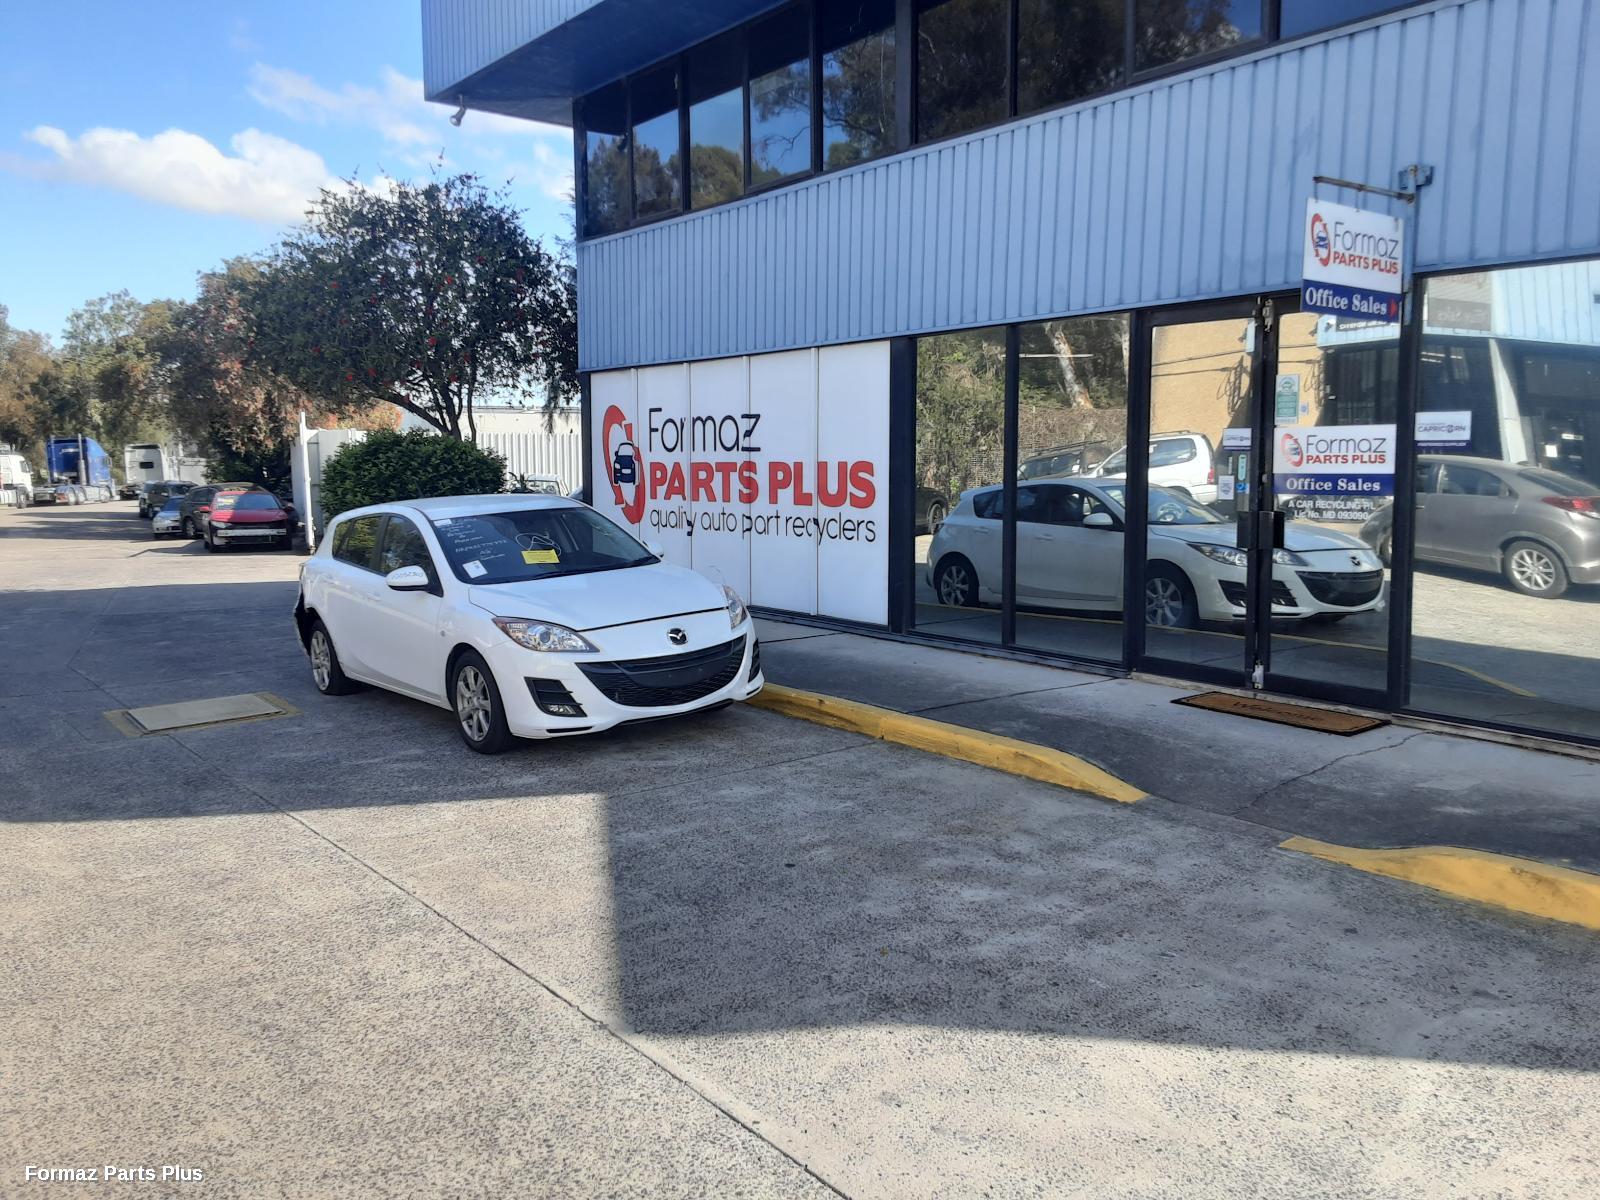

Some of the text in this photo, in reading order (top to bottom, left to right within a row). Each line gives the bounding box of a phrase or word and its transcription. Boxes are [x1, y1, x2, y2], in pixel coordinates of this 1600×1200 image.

[1333, 221, 1400, 261] Formaz
[1332, 251, 1399, 275] PARTS PLUS
[1305, 287, 1388, 316] Office Sales
[648, 407, 761, 453] Formaz
[1305, 433, 1387, 455] Formaz
[1305, 453, 1387, 465] PARTS PLUS
[649, 460, 877, 510] PARTS PLUS
[1286, 477, 1381, 492] Office Sales
[1296, 500, 1313, 508] CAR
[701, 506, 738, 532] auto
[742, 509, 781, 540] part
[785, 511, 877, 546] recyclers
